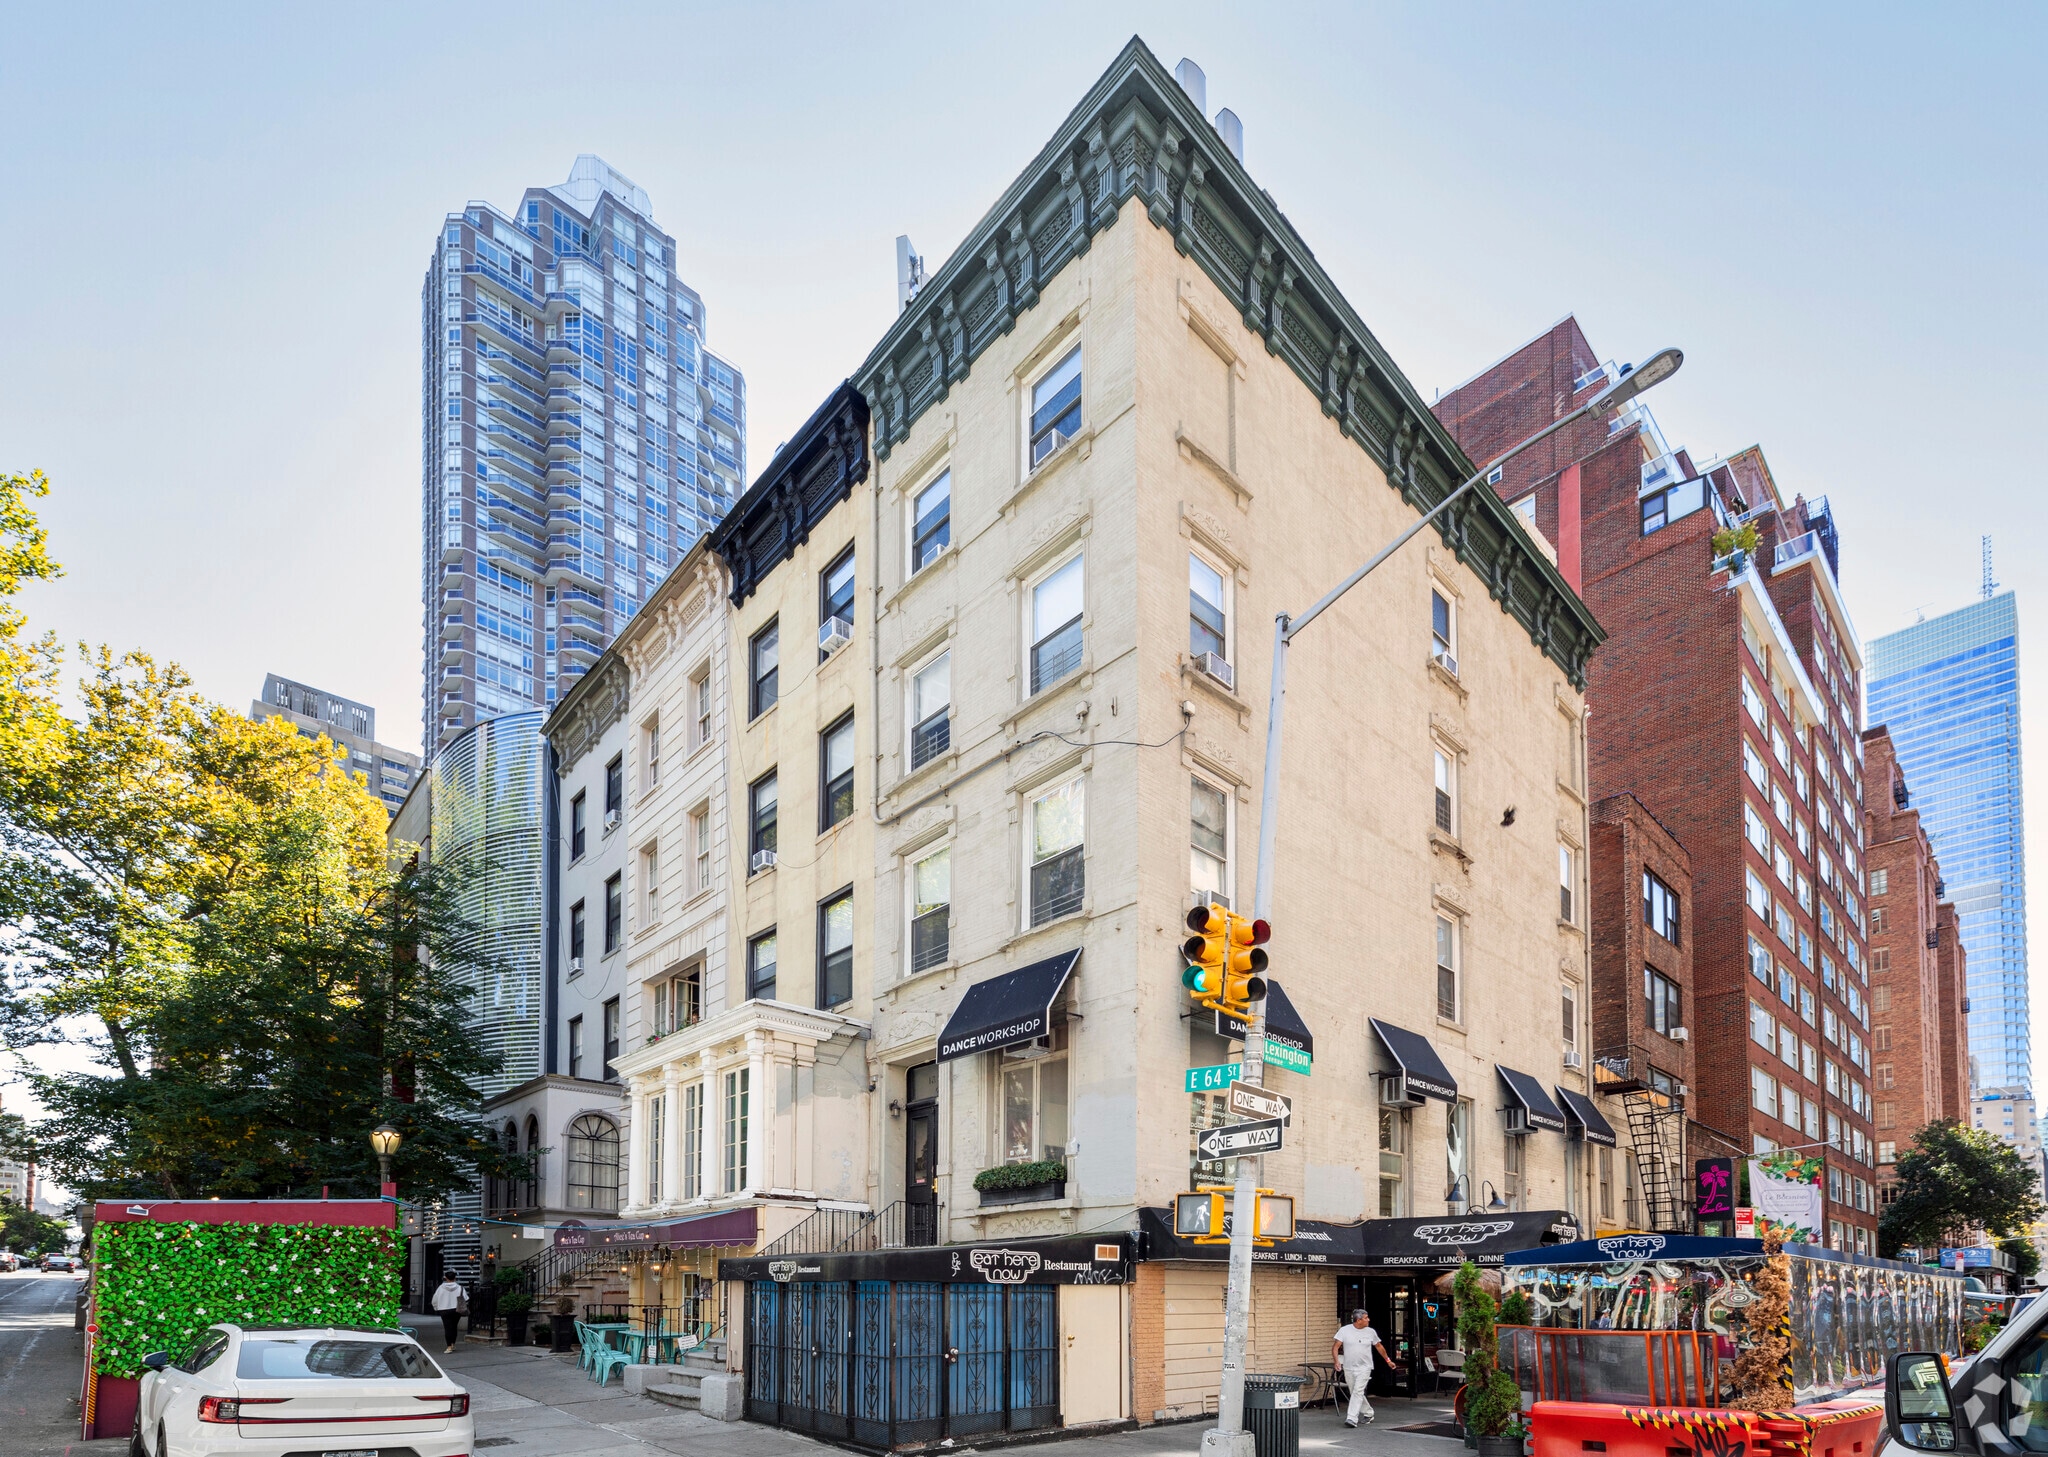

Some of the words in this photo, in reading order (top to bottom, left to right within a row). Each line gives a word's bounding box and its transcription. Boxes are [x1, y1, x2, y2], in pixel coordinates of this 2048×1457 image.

[1264, 1040, 1308, 1067] Lexington
[1264, 1055, 1283, 1065] Avenue
[1191, 1072, 1198, 1088] E
[1204, 1068, 1222, 1087] 64
[1227, 1064, 1237, 1077] St
[1236, 1092, 1255, 1109] ONE
[1265, 1100, 1284, 1116] WAY
[1209, 1136, 1233, 1150] ONE
[1247, 1128, 1275, 1145] WAY
[1419, 1226, 1454, 1235] eat
[1458, 1223, 1508, 1234] here
[1436, 1234, 1477, 1243] now
[1601, 1240, 1625, 1249] eat
[1629, 1238, 1662, 1248] here
[1285, 1253, 1302, 1261] LUNCH
[1308, 1254, 1327, 1263] DINNER
[1618, 1249, 1645, 1258] now
[973, 1252, 1000, 1266] eat
[1004, 1251, 1037, 1267] here
[1044, 1258, 1092, 1272] Restaurant
[1383, 1256, 1428, 1265] BREAKFAST
[1439, 1255, 1468, 1264] LUNCH
[1478, 1254, 1504, 1263] DINNE
[797, 1265, 821, 1273] Restaurant
[993, 1268, 1021, 1280] now
